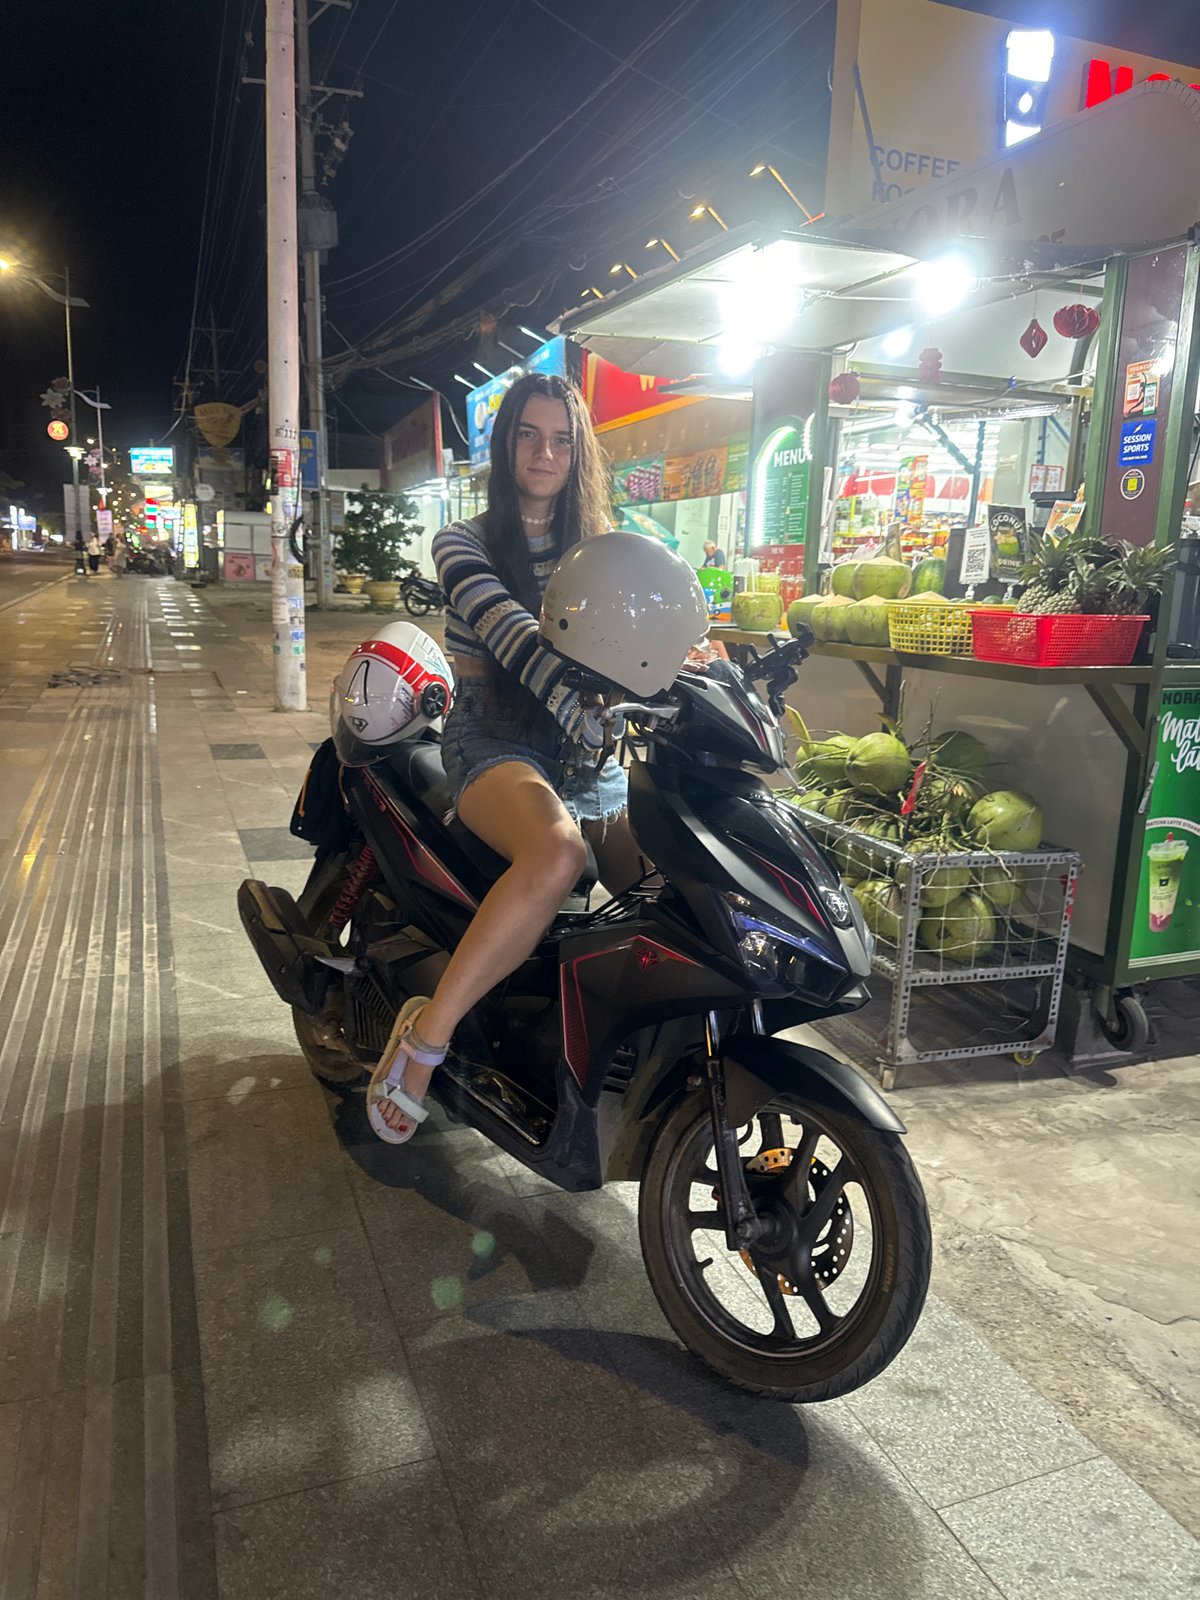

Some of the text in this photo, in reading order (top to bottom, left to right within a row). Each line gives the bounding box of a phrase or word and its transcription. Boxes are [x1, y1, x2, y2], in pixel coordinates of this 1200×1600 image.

[870, 146, 960, 178] COFFEE
[1122, 443, 1150, 453] SPORTS
[1123, 434, 1152, 444] SESSION
[773, 448, 807, 468] MENU
[990, 515, 1024, 534] COCONUT
[998, 558, 1021, 567] DRINK
[881, 1243, 894, 1293] KENDA
